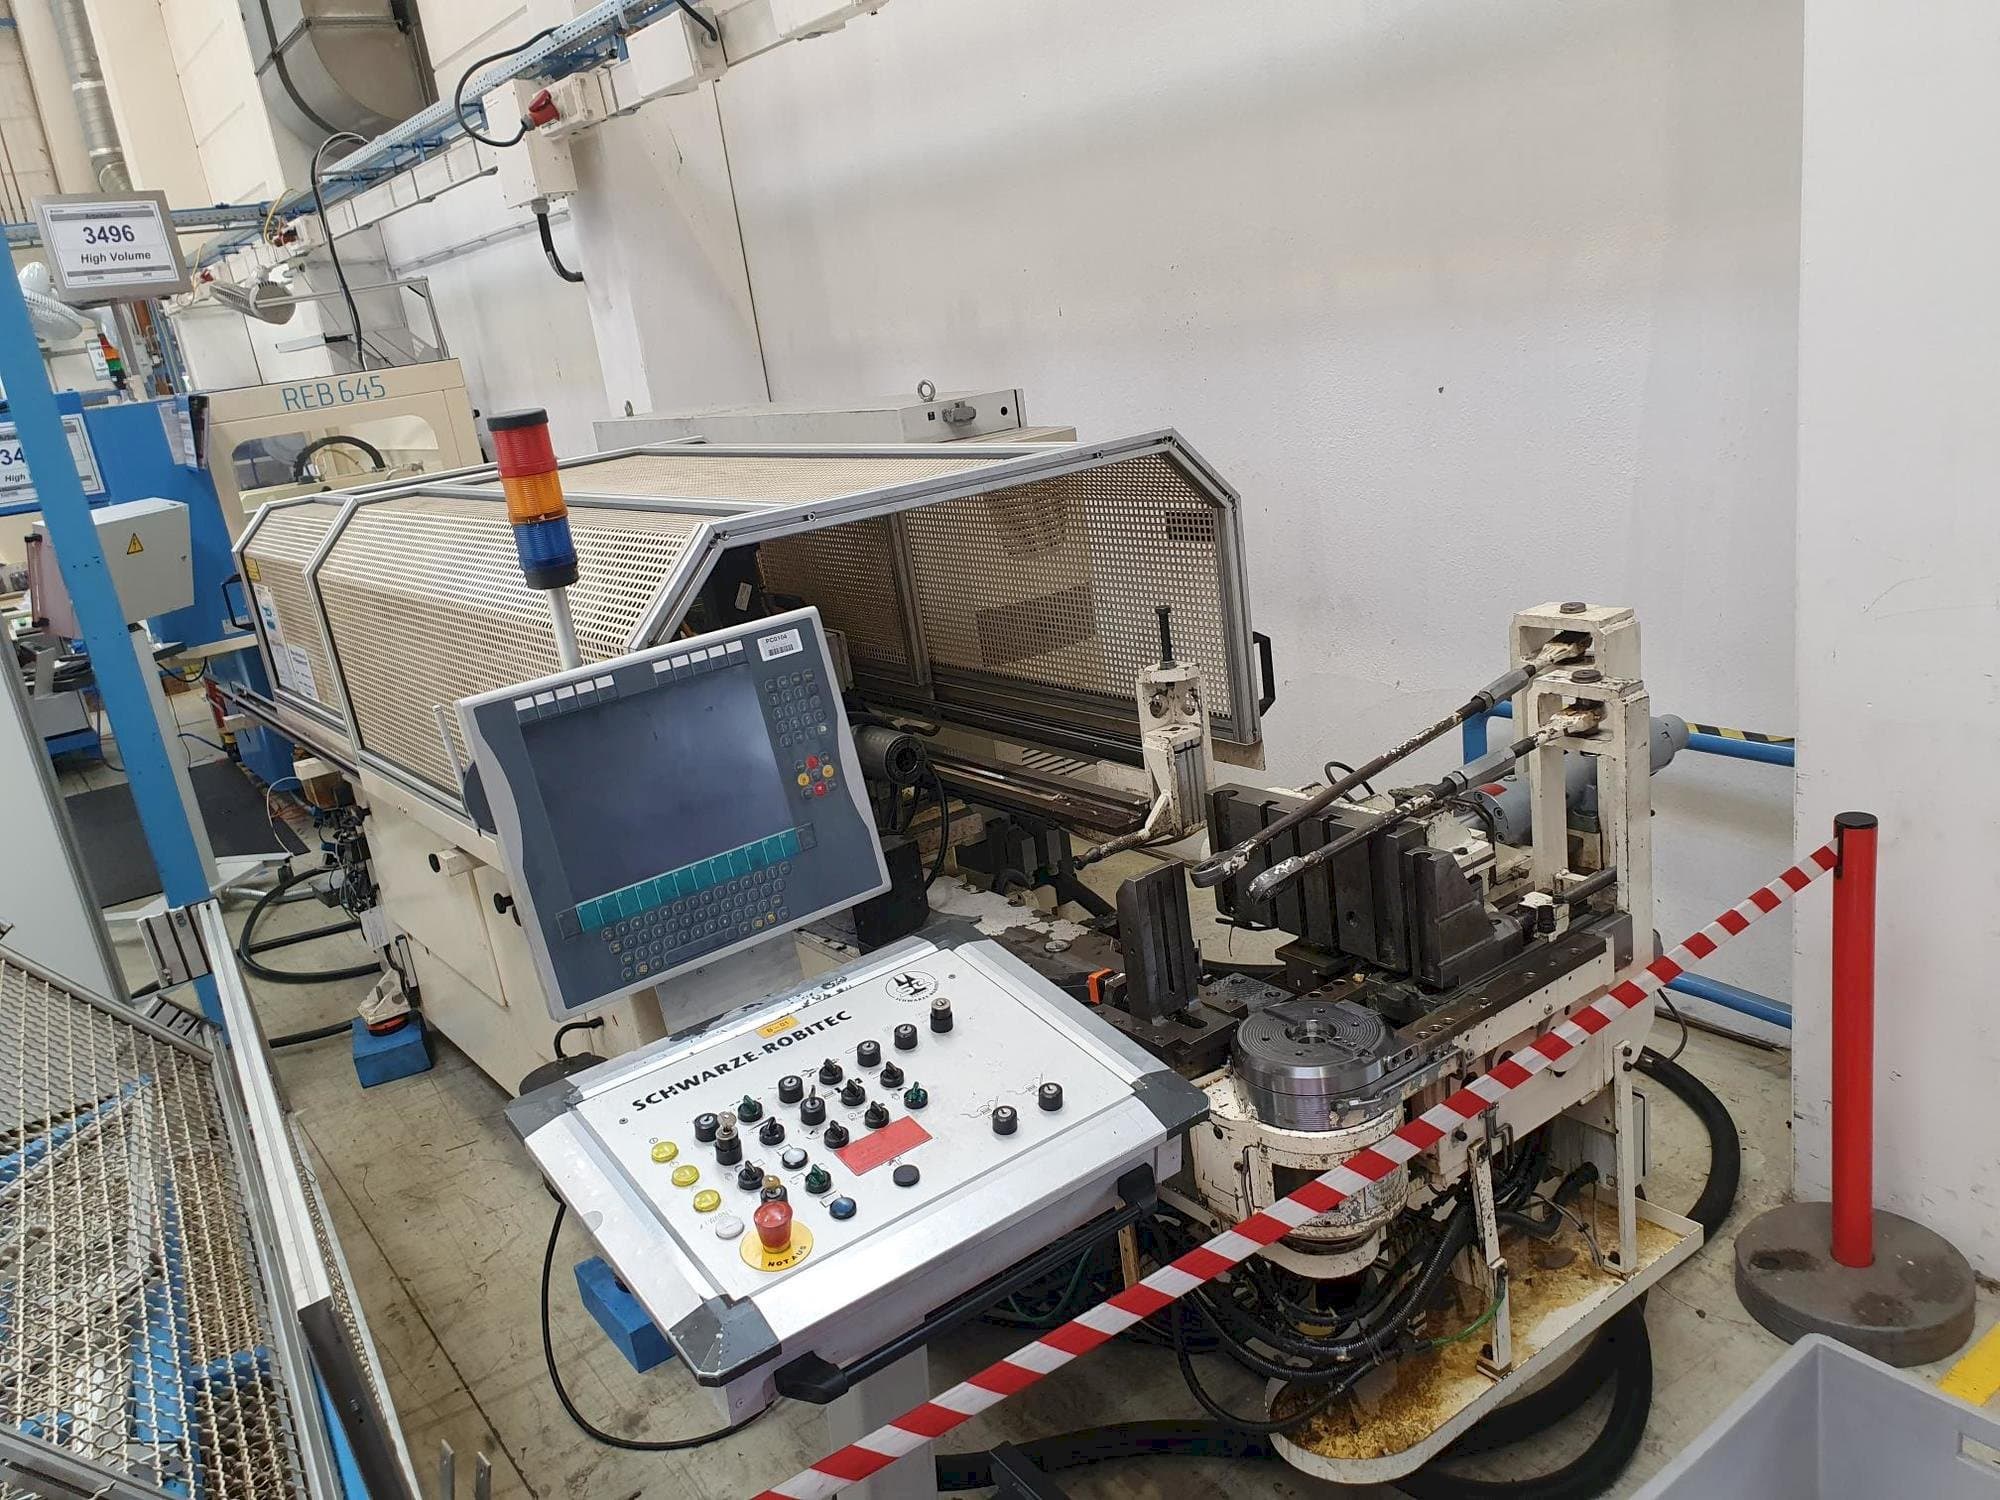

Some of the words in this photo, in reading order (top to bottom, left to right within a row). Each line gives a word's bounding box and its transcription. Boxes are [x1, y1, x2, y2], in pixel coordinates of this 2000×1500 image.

[83, 224, 136, 245] 3496
[80, 252, 107, 265] High
[110, 251, 152, 264] Volume
[281, 382, 335, 411] REB
[337, 375, 386, 403] 645
[0, 447, 26, 466] 34
[4, 473, 26, 483] High
[631, 1010, 853, 1112] SCHWARZE-ROBITEC
[767, 1258, 789, 1268] NOT
[790, 1244, 807, 1262] AUS
